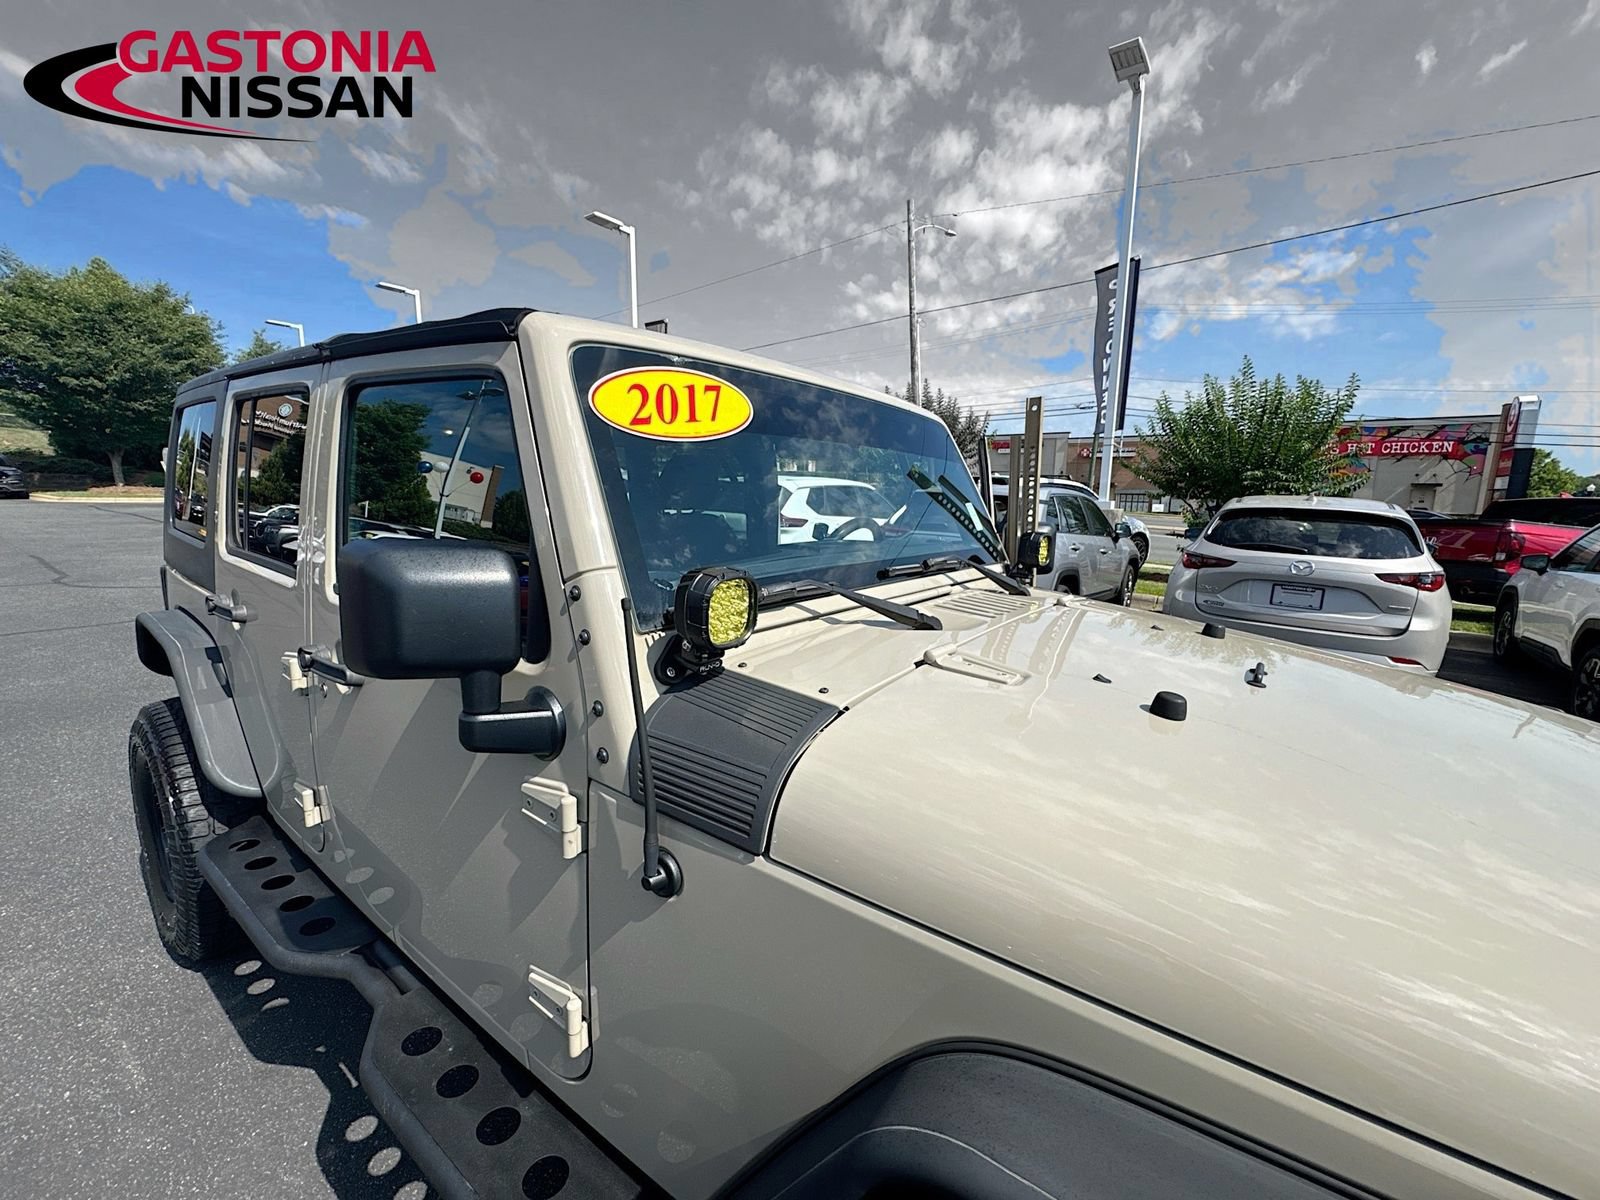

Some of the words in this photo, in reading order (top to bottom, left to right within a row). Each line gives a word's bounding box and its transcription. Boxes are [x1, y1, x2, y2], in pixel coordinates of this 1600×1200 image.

[627, 383, 721, 426] 2017
[1347, 442, 1375, 455] HT
[1381, 441, 1454, 454] CHICKEN
